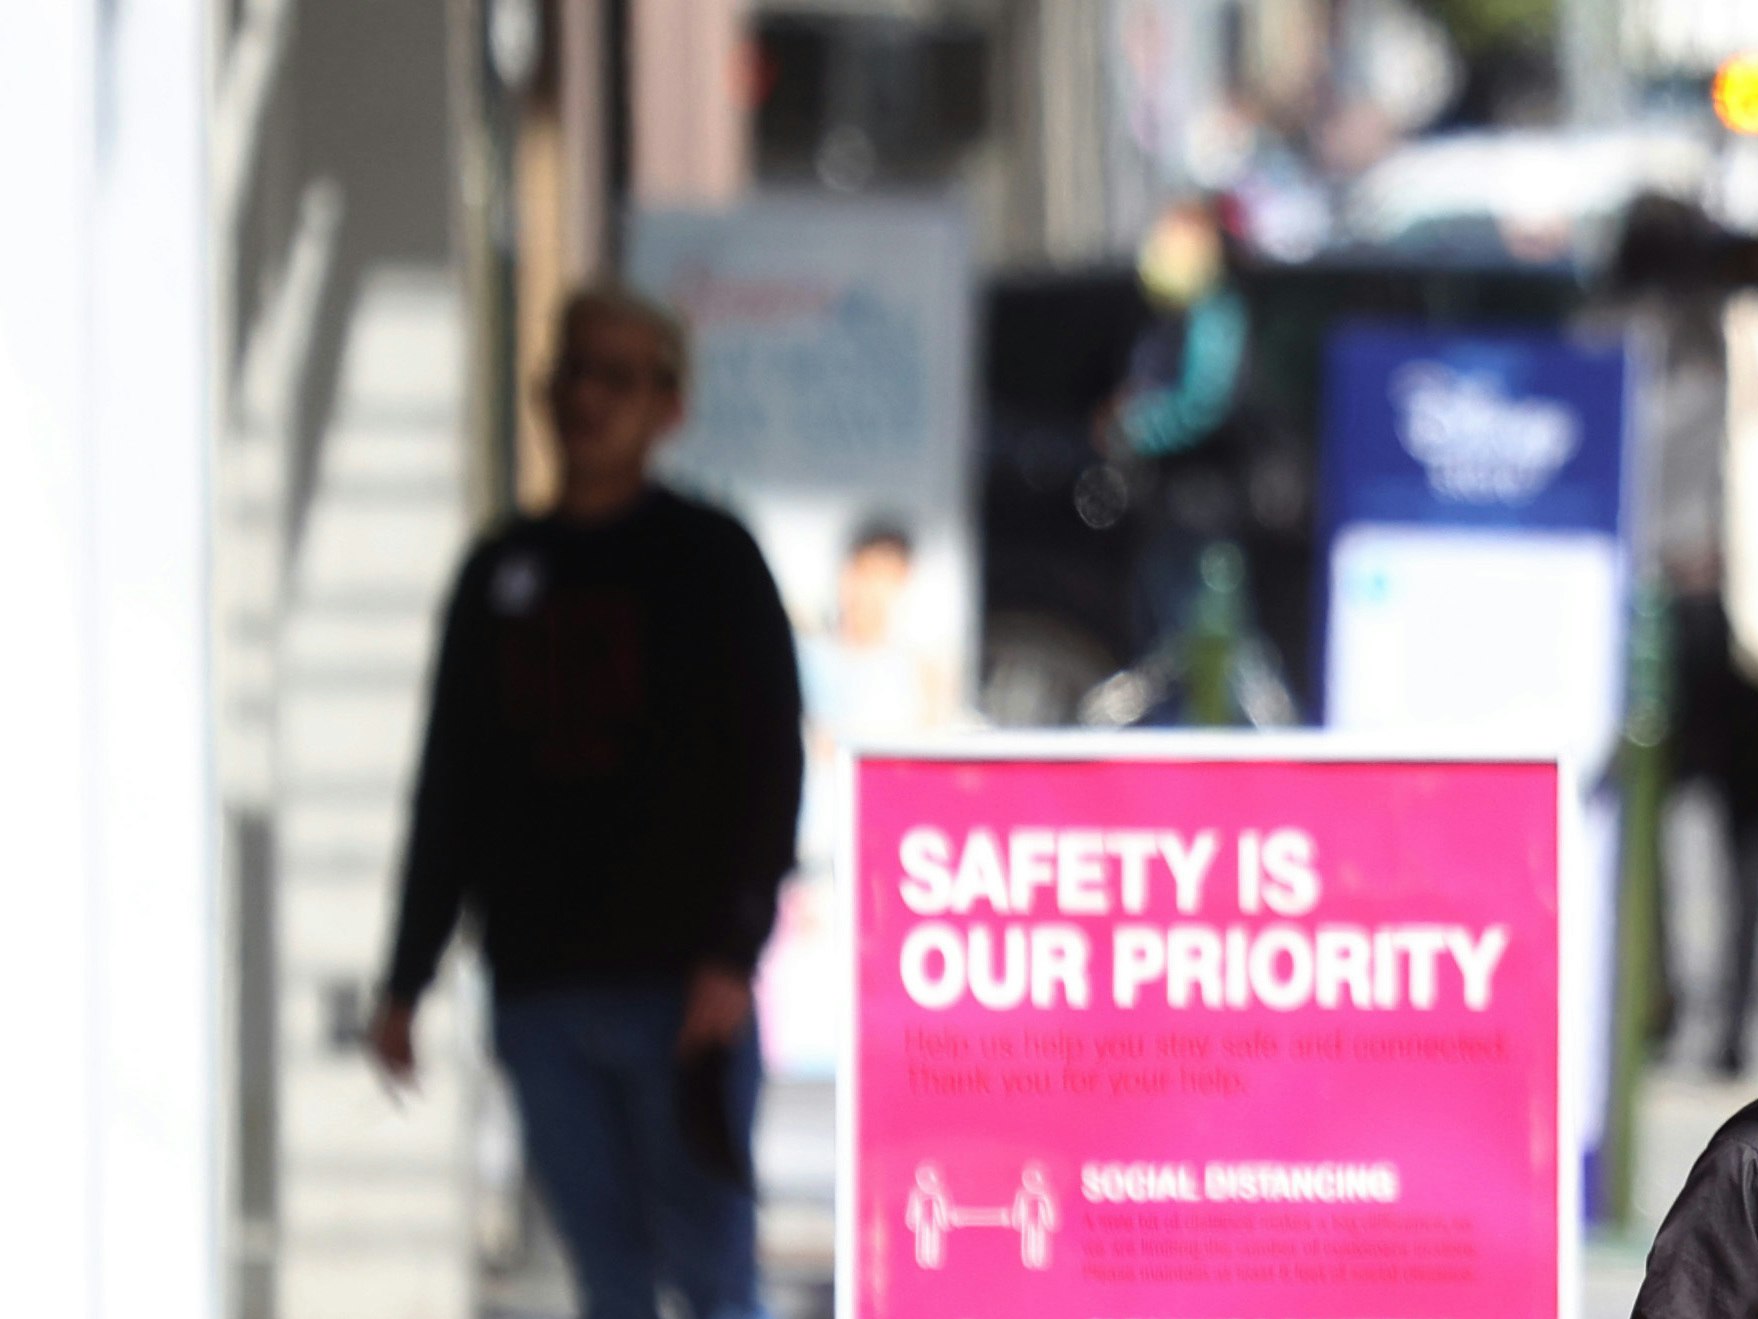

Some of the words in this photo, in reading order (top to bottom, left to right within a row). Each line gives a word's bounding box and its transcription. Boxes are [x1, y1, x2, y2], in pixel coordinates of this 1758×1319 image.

[899, 826, 1217, 916] SAFETY
[1237, 827, 1322, 916] IS
[899, 923, 1092, 1011] OUR
[1111, 924, 1510, 1012] PRIORITY
[903, 1026, 968, 1062] Help
[979, 1034, 1013, 1058] us
[1024, 1027, 1084, 1063] help
[1093, 1034, 1145, 1064] you
[1155, 1030, 1210, 1064] stay
[1222, 1029, 1279, 1060] safe
[1290, 1029, 1343, 1060] and
[906, 1065, 990, 1096] Thank
[1000, 1072, 1051, 1100] you
[1062, 1066, 1098, 1094] for
[1108, 1072, 1169, 1100] your
[1081, 1160, 1198, 1203] SOCIAL
[1204, 1160, 1398, 1203] DISTANCING
